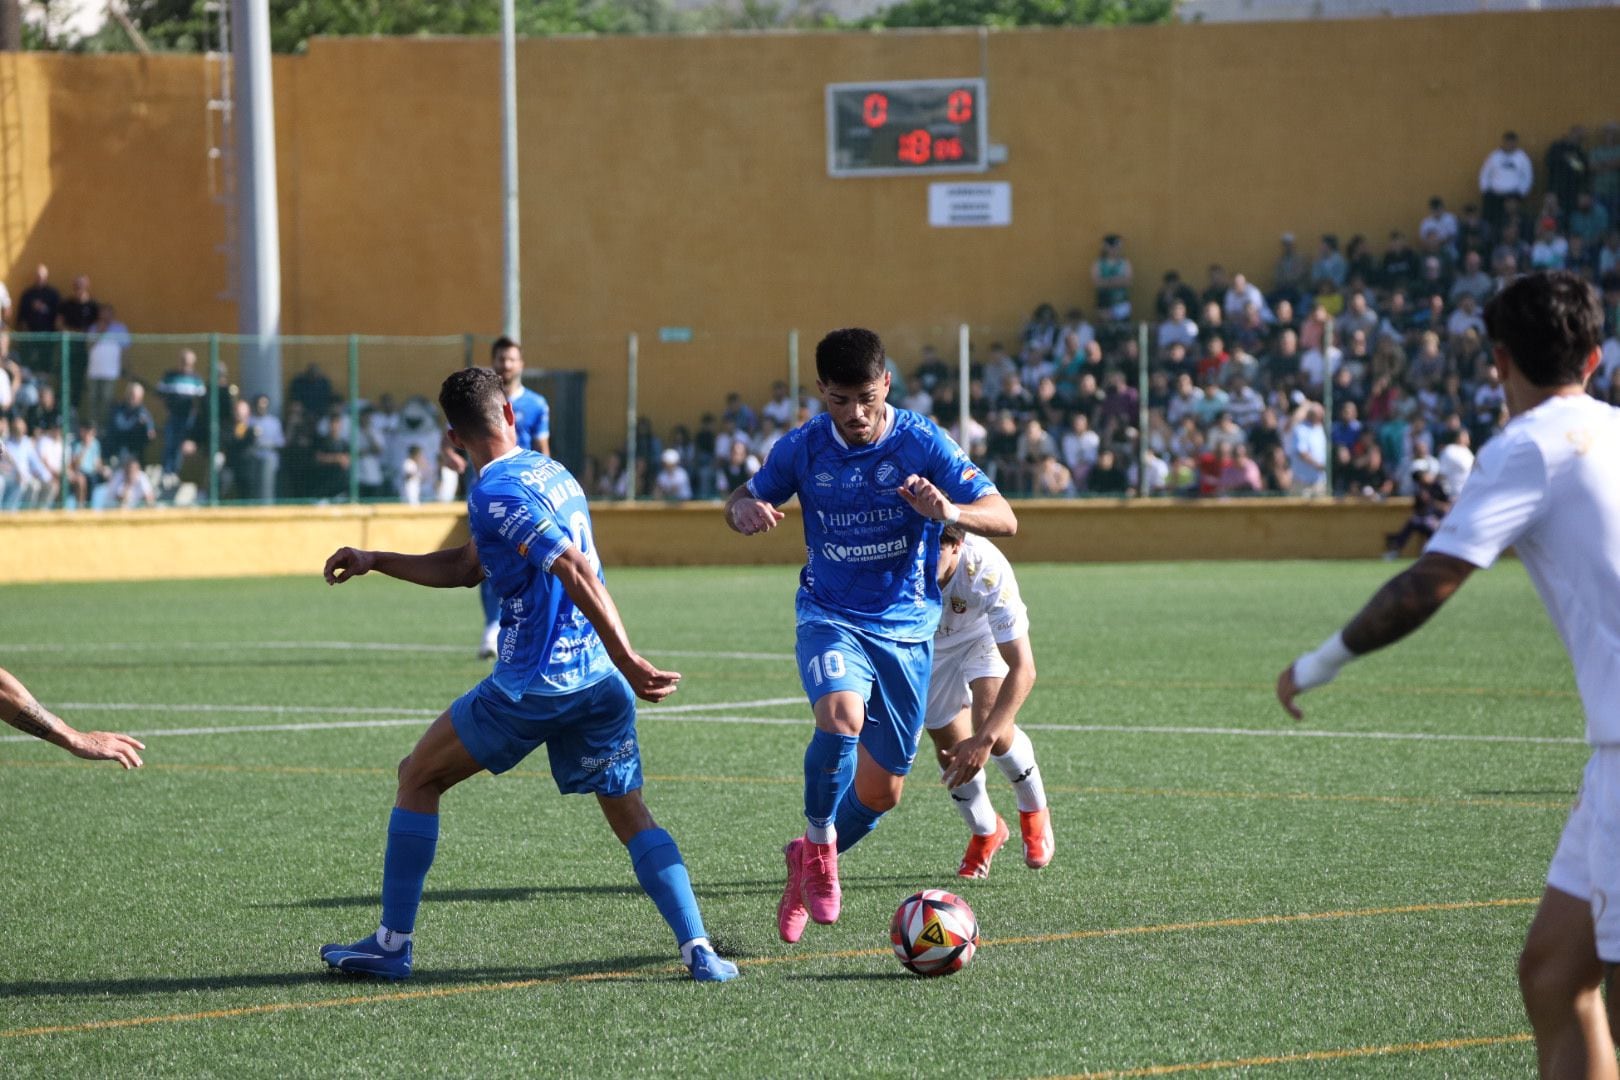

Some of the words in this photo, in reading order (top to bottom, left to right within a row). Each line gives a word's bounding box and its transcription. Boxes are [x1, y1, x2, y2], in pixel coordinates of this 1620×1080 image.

[863, 92, 888, 128] 0
[829, 507, 904, 526] HIPOTELS
[846, 535, 908, 556] romeral
[808, 650, 846, 687] 10
